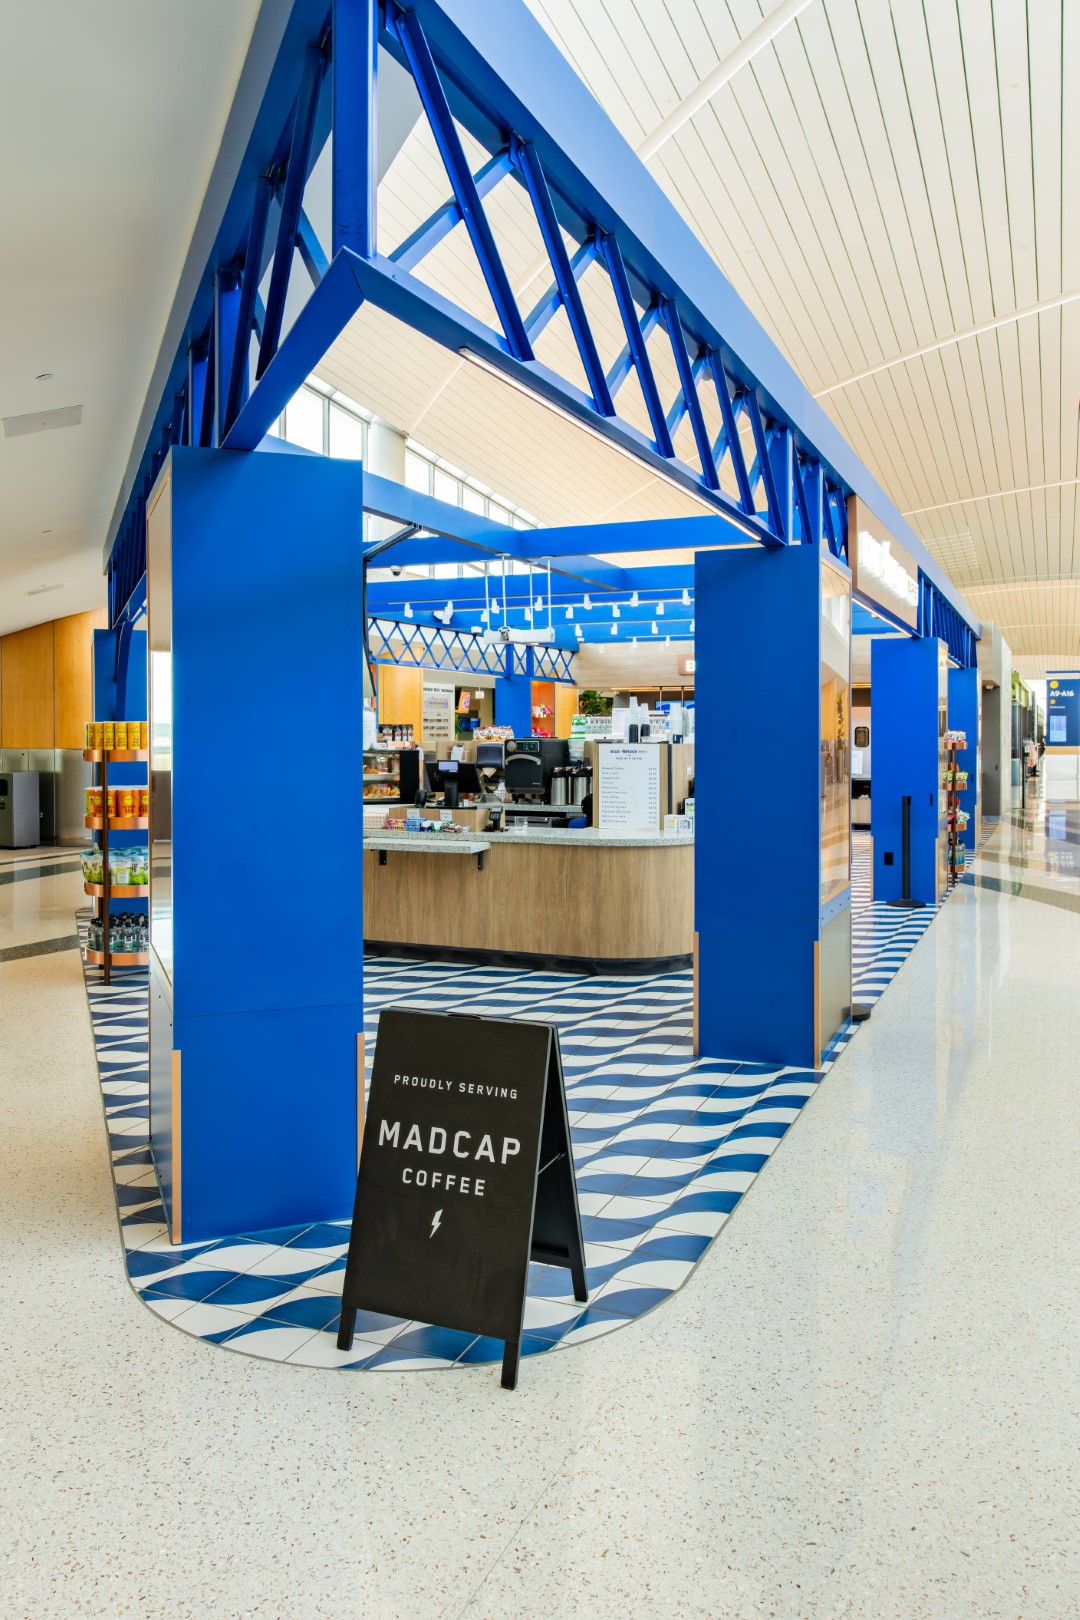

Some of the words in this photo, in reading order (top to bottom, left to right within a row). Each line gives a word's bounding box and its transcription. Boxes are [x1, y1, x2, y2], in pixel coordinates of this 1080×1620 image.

[393, 1074, 453, 1091] PROUDLY
[458, 1082, 518, 1100] SERVING
[378, 1119, 521, 1165] MADCAP
[402, 1167, 486, 1197] COFFEE
